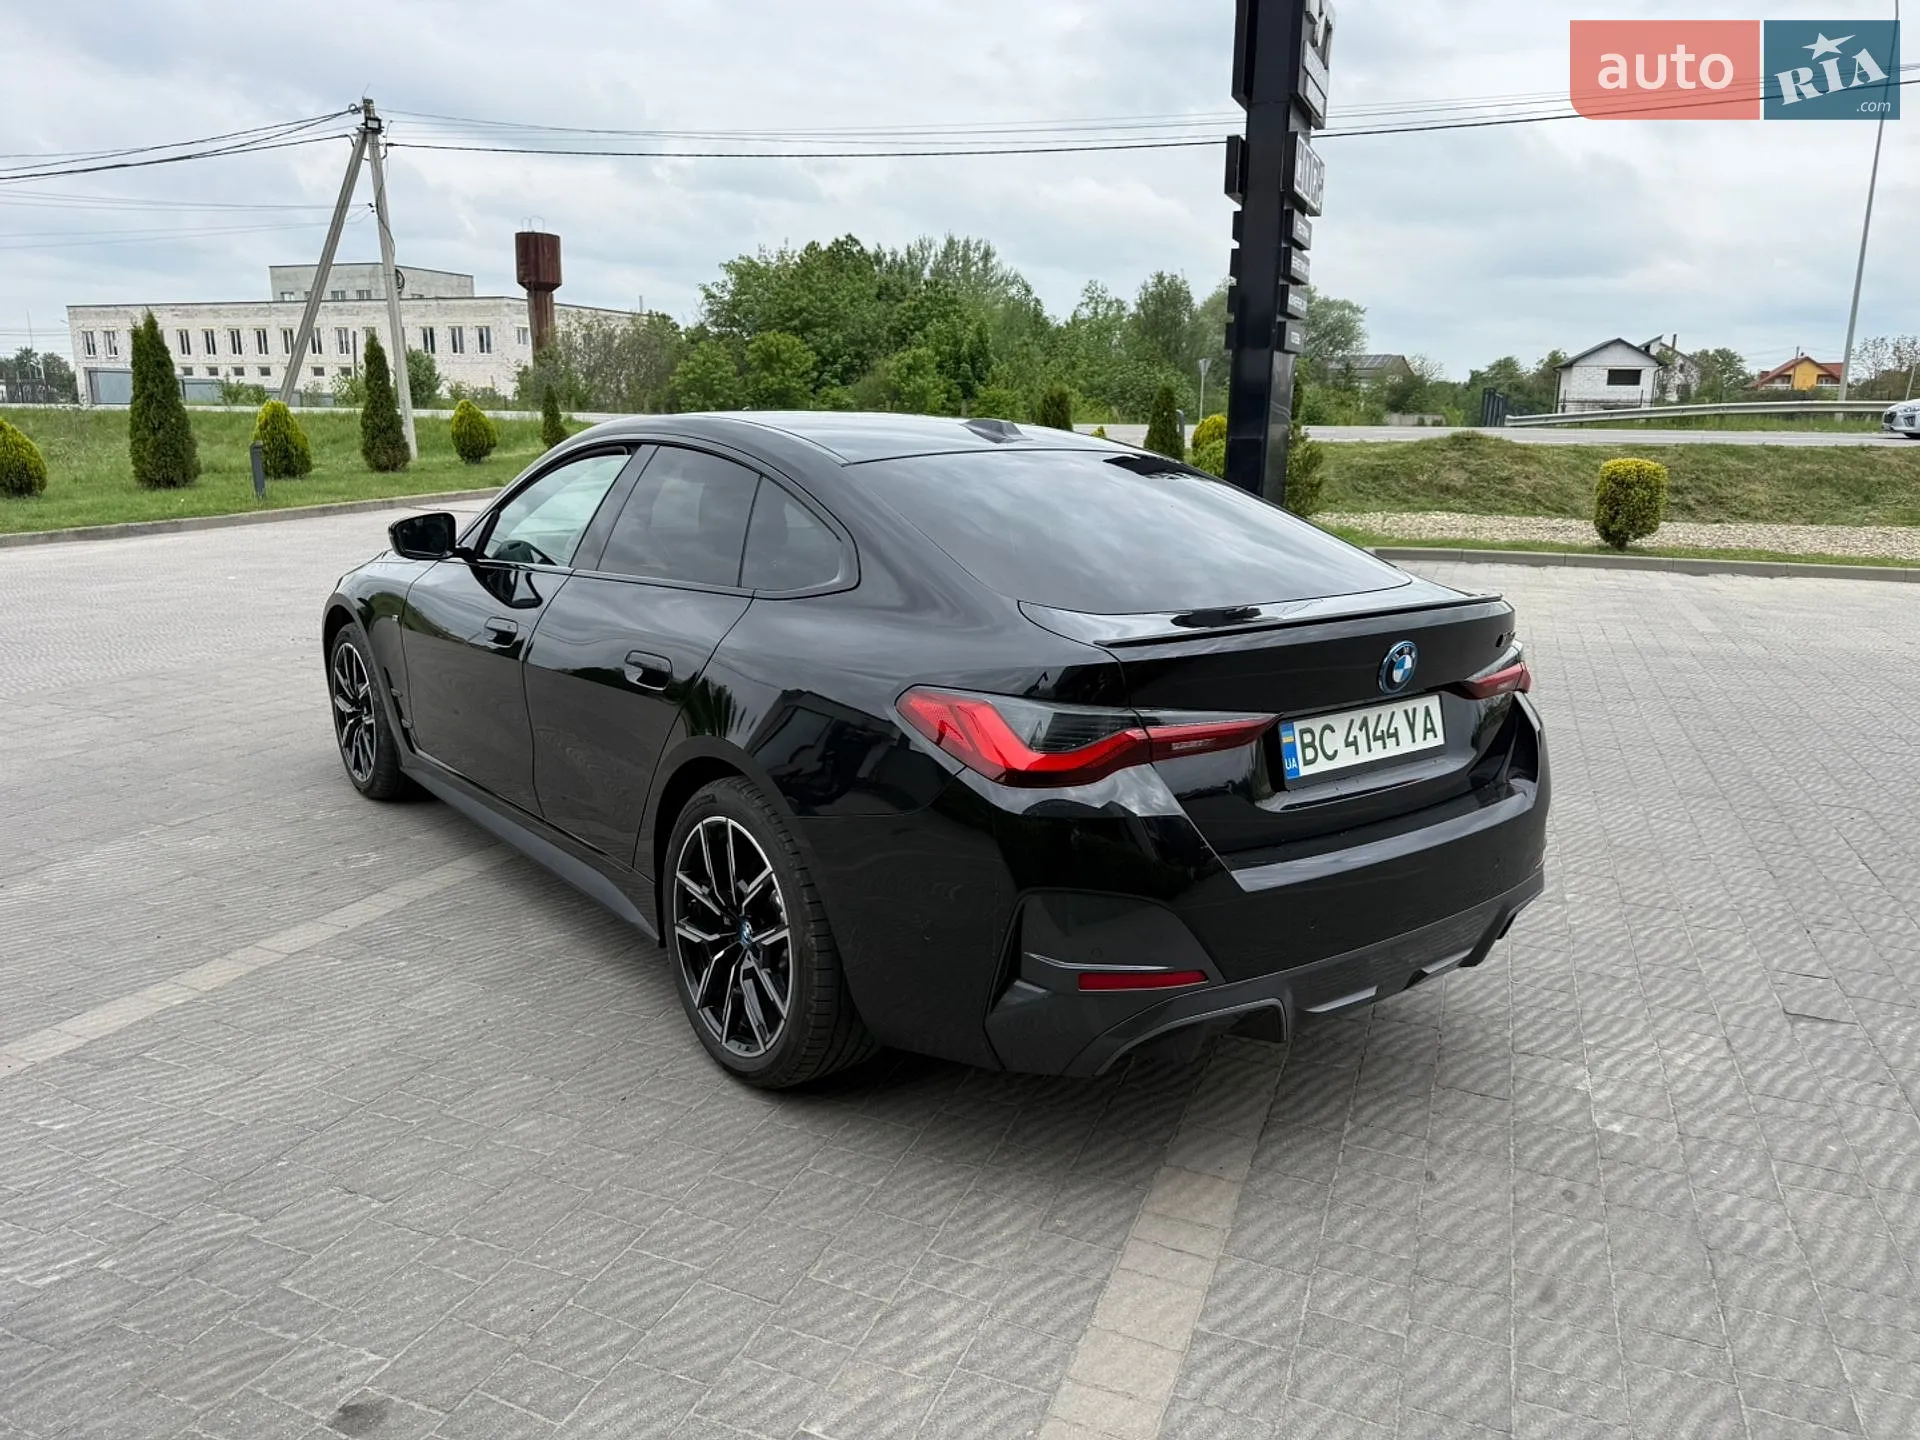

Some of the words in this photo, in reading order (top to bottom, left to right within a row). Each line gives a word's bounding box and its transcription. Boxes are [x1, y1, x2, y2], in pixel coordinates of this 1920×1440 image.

[1298, 723, 1339, 767] BC
[1344, 710, 1400, 756] 4144
[1403, 705, 1438, 743] YA
[1284, 758, 1298, 771] UA
